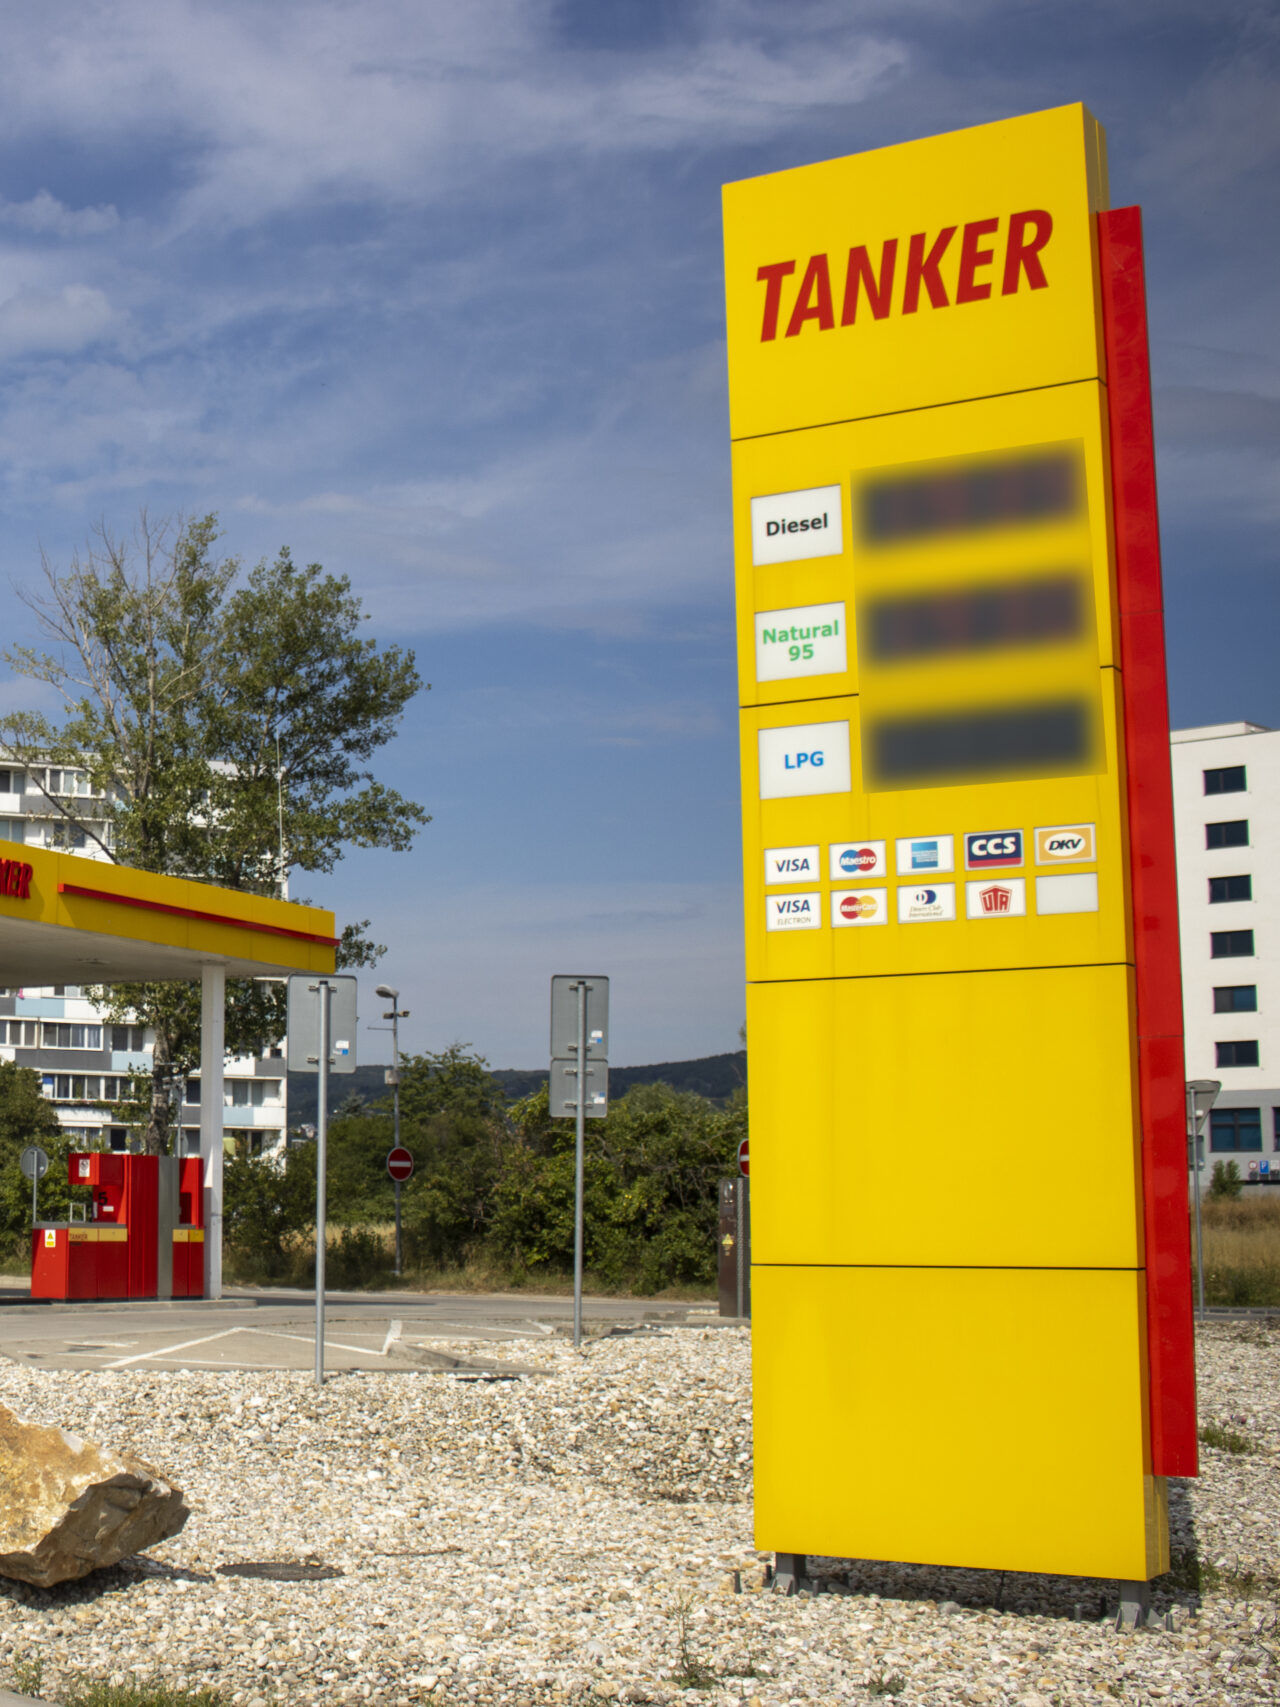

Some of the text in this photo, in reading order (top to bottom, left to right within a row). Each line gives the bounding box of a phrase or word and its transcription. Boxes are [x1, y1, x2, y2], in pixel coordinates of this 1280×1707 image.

[757, 209, 1053, 343] TANKER
[766, 512, 829, 537] Diesel
[762, 620, 839, 645] Natural
[788, 644, 814, 662] 95
[784, 751, 825, 770] LPG
[971, 837, 1016, 856] CCS
[1049, 838, 1082, 851] DKV
[775, 858, 810, 872] VISA
[840, 855, 877, 866] Maestro
[776, 900, 811, 914] VISA
[840, 903, 877, 912] MasterCard
[982, 888, 1010, 912] UTA
[777, 916, 812, 926] ELECTRON
[98, 1191, 109, 1206] 5
